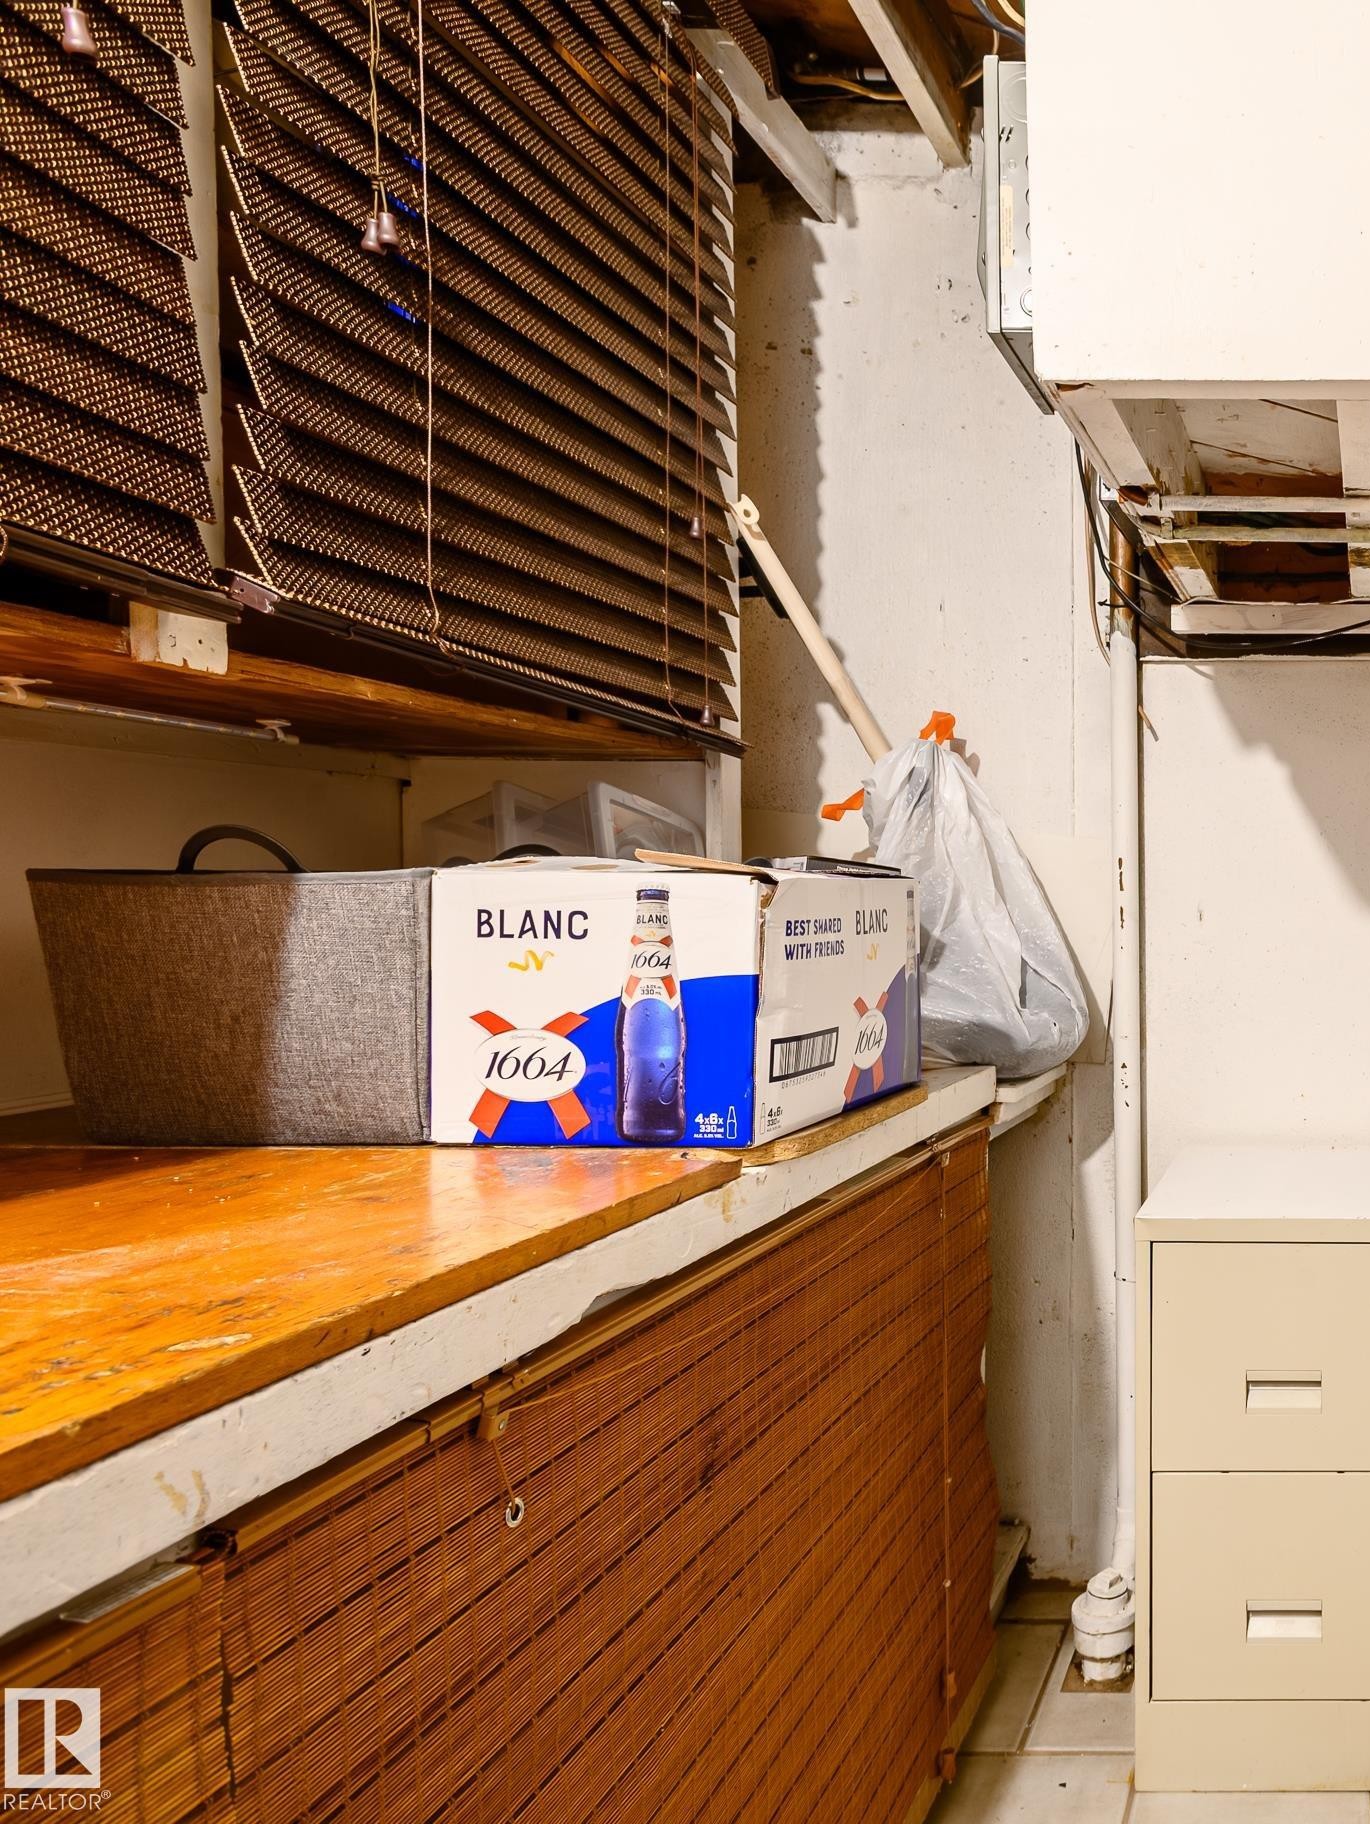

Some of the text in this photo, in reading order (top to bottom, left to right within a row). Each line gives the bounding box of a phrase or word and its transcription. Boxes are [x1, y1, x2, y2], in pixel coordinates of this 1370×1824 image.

[477, 909, 589, 940] BLANC
[636, 914, 668, 924] BLANC
[785, 918, 842, 936] BEST SHARED
[855, 908, 888, 935] BLANC
[630, 951, 672, 969] 1664
[784, 940, 845, 960] WITH FRIENDS
[854, 1023, 884, 1055] 1664
[485, 1046, 574, 1081] 1664
